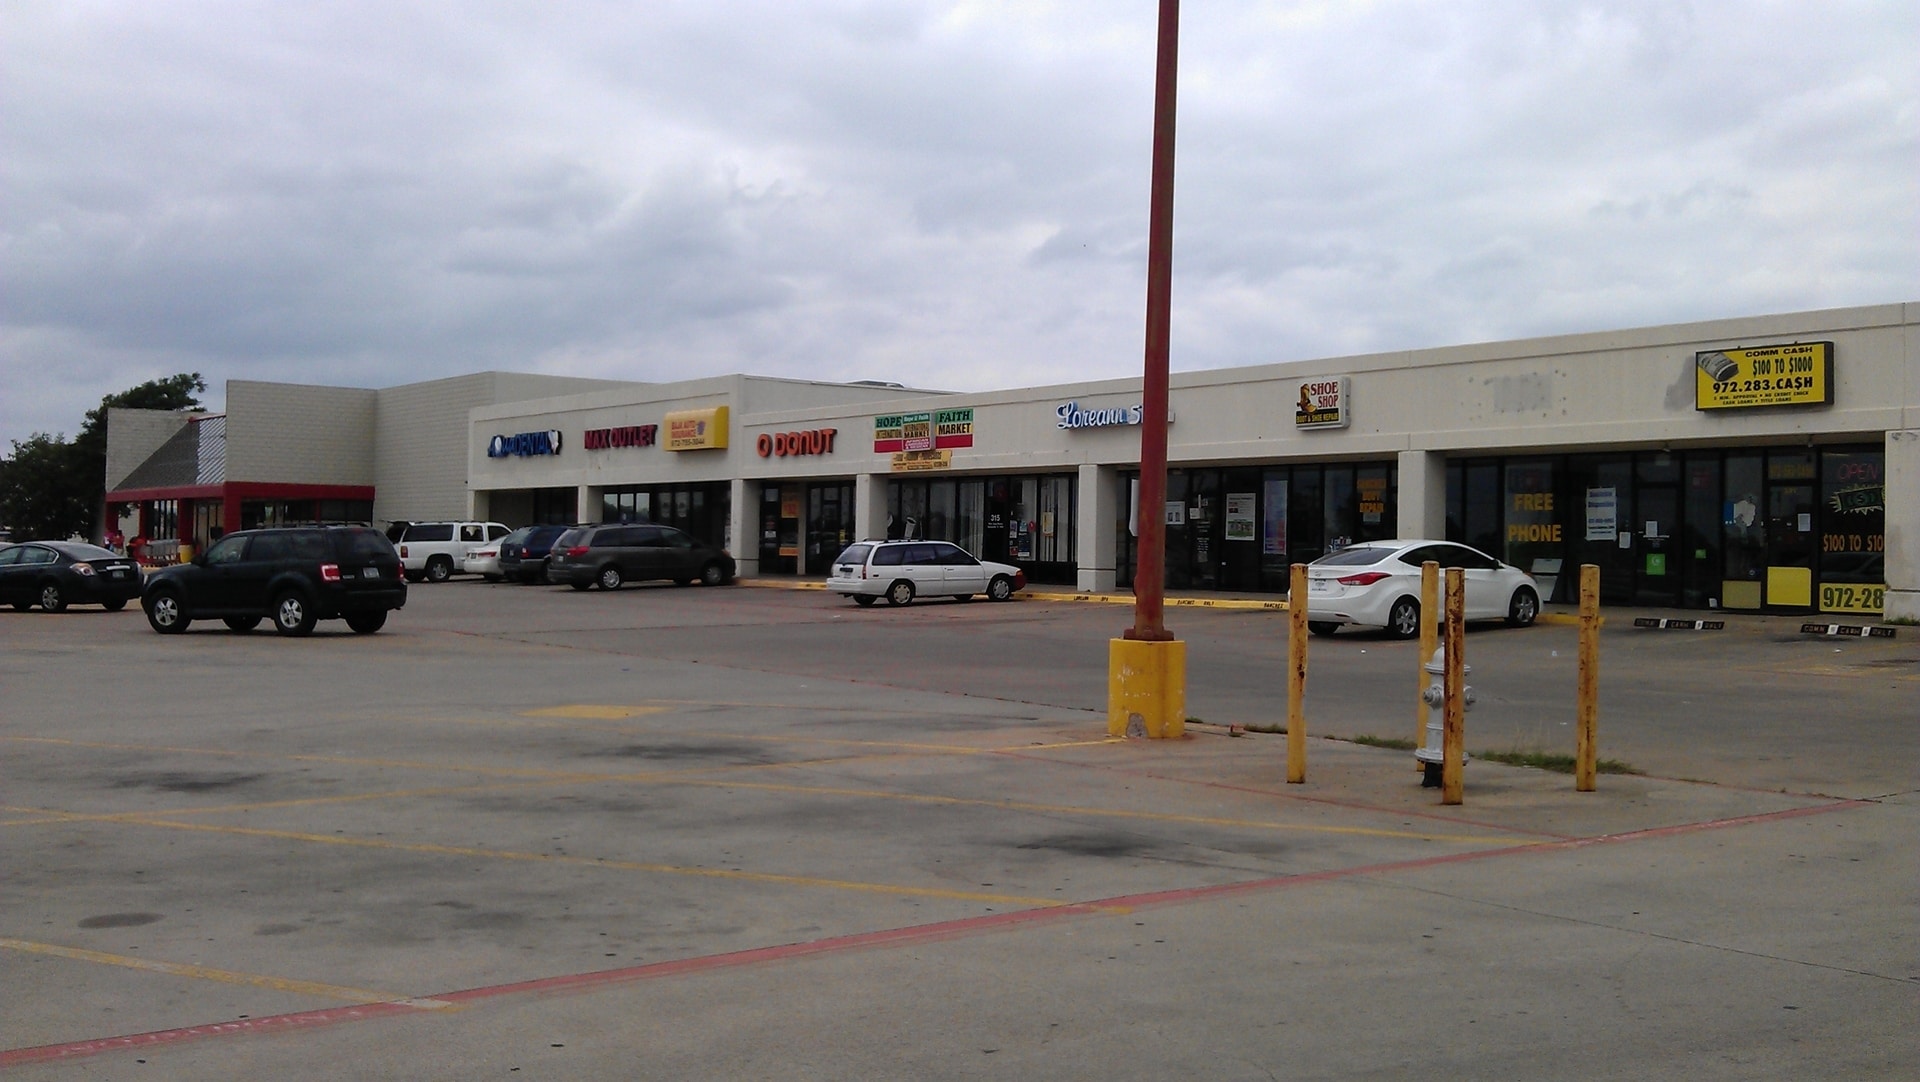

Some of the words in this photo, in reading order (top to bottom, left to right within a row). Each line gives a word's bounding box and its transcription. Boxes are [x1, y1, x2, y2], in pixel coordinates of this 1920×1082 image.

[1745, 349, 1779, 358] COMM
[1783, 346, 1813, 355] CASH
[1752, 358, 1771, 377] $100
[1774, 358, 1785, 374] TO
[1788, 355, 1813, 375] $1000
[1310, 381, 1339, 396] SHOE
[1712, 376, 1813, 393] 972.283.CA$H
[1317, 394, 1339, 408] SHOP
[876, 416, 902, 428] HOPE
[939, 411, 971, 423] FAITH
[1056, 401, 1126, 429] Loreann
[584, 428, 611, 450] MAX
[611, 424, 658, 448] OUTLET
[938, 423, 971, 435] MARKET
[757, 433, 772, 457] O
[774, 428, 837, 456] DONUT
[1838, 463, 1878, 480] OPEN
[1514, 493, 1554, 511] FREE
[990, 514, 1001, 522] 315
[1508, 524, 1562, 542] PHONE
[1822, 533, 1846, 552] $100
[1849, 535, 1862, 551] TO
